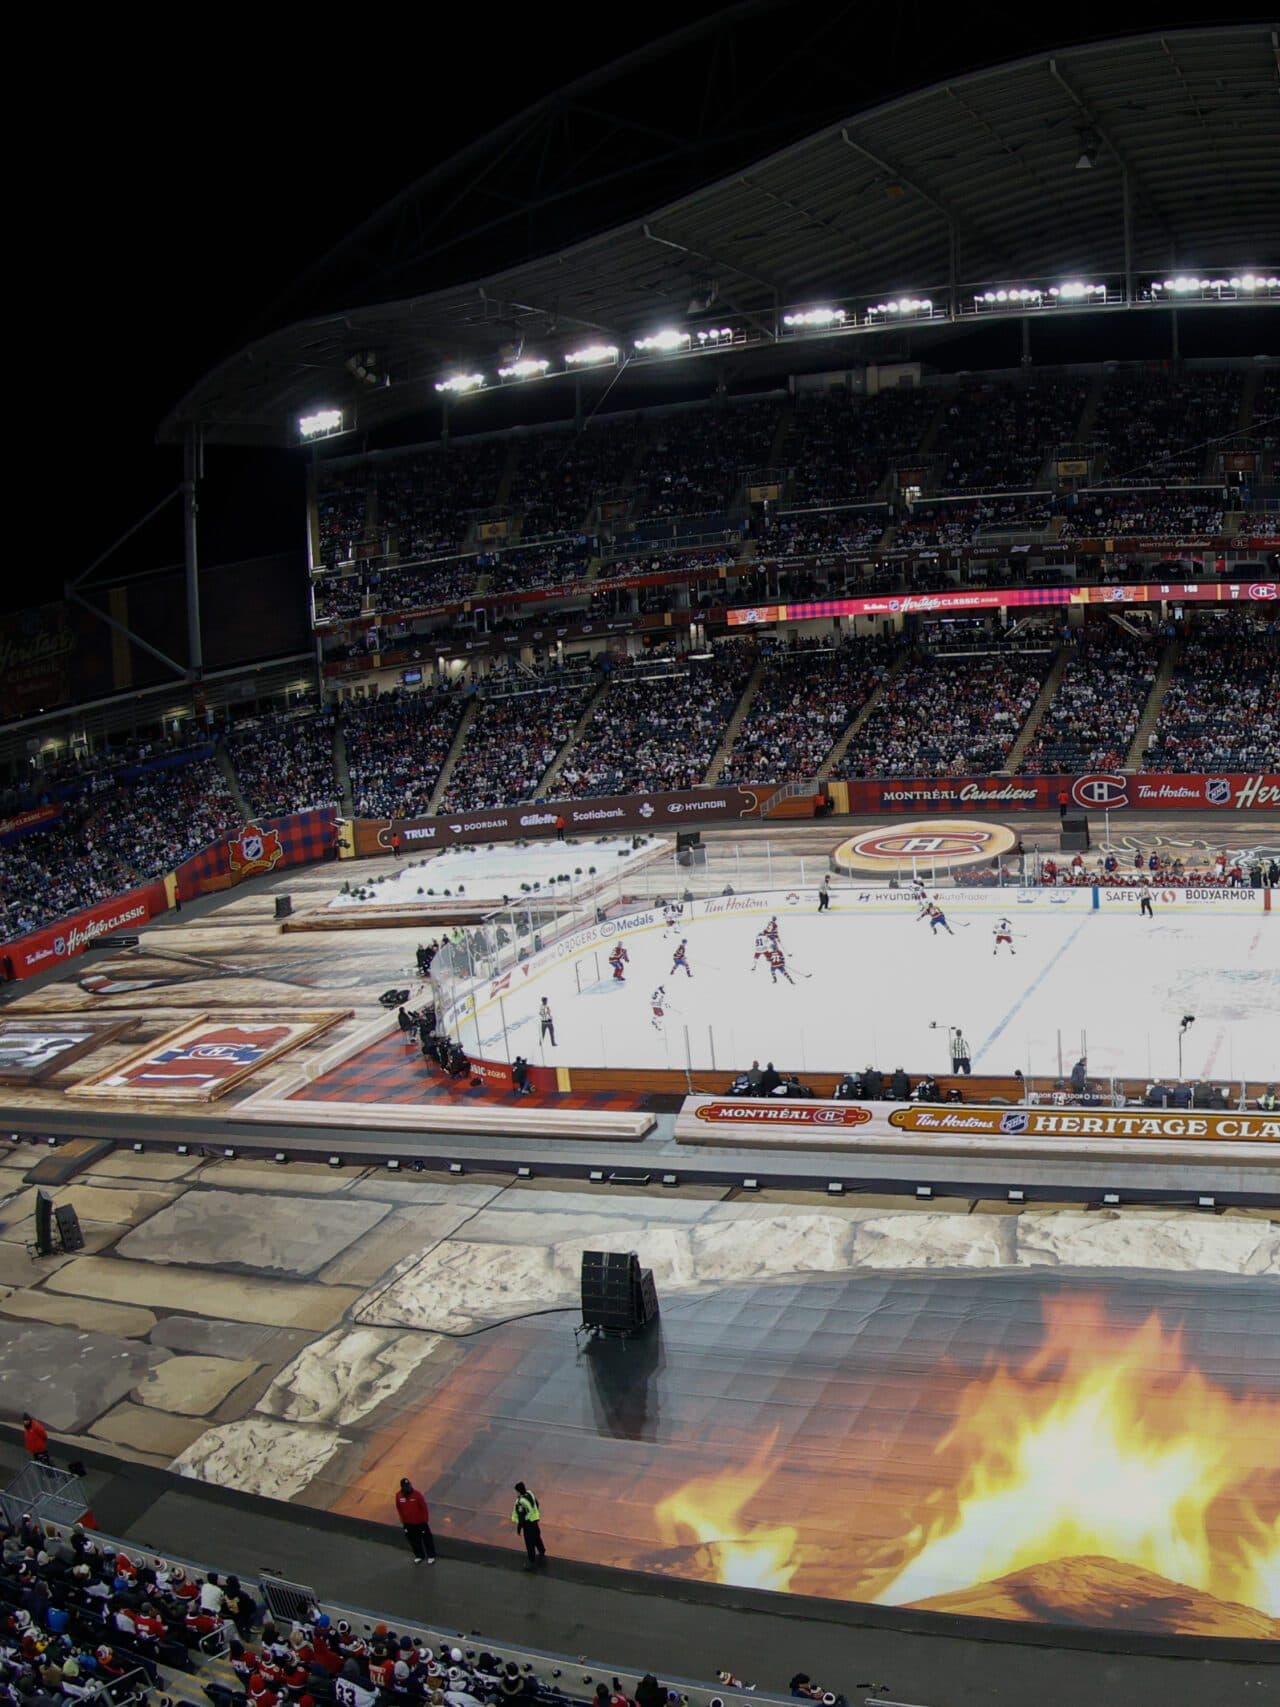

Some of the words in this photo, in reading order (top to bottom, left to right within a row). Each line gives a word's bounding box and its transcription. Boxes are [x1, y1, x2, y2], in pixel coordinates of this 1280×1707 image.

[900, 596, 942, 612] Heritage
[941, 597, 980, 606] CLASSIC
[884, 788, 959, 800] MONTRÉAL
[959, 783, 1038, 801] Canadiens
[1137, 785, 1161, 798] Tim
[1161, 785, 1200, 798] Hortons
[685, 800, 727, 811] HYUNDAI
[464, 819, 508, 831] DOORDASH
[520, 814, 558, 826] Gillette
[404, 827, 436, 840] TRULY
[938, 893, 988, 901] AutoTrader
[1185, 889, 1256, 901] BODYARMOR
[703, 900, 725, 913] Tim
[726, 898, 768, 912] Hortons
[616, 914, 654, 932] Medals
[67, 920, 109, 956] Heritage
[108, 905, 145, 929] CLASSIC
[563, 930, 598, 949] ROGERS
[718, 1108, 811, 1120] MONTRÉAL
[915, 1112, 942, 1128] Tim
[942, 1113, 994, 1129] Hortons
[1034, 1115, 1207, 1136] HERITAGE
